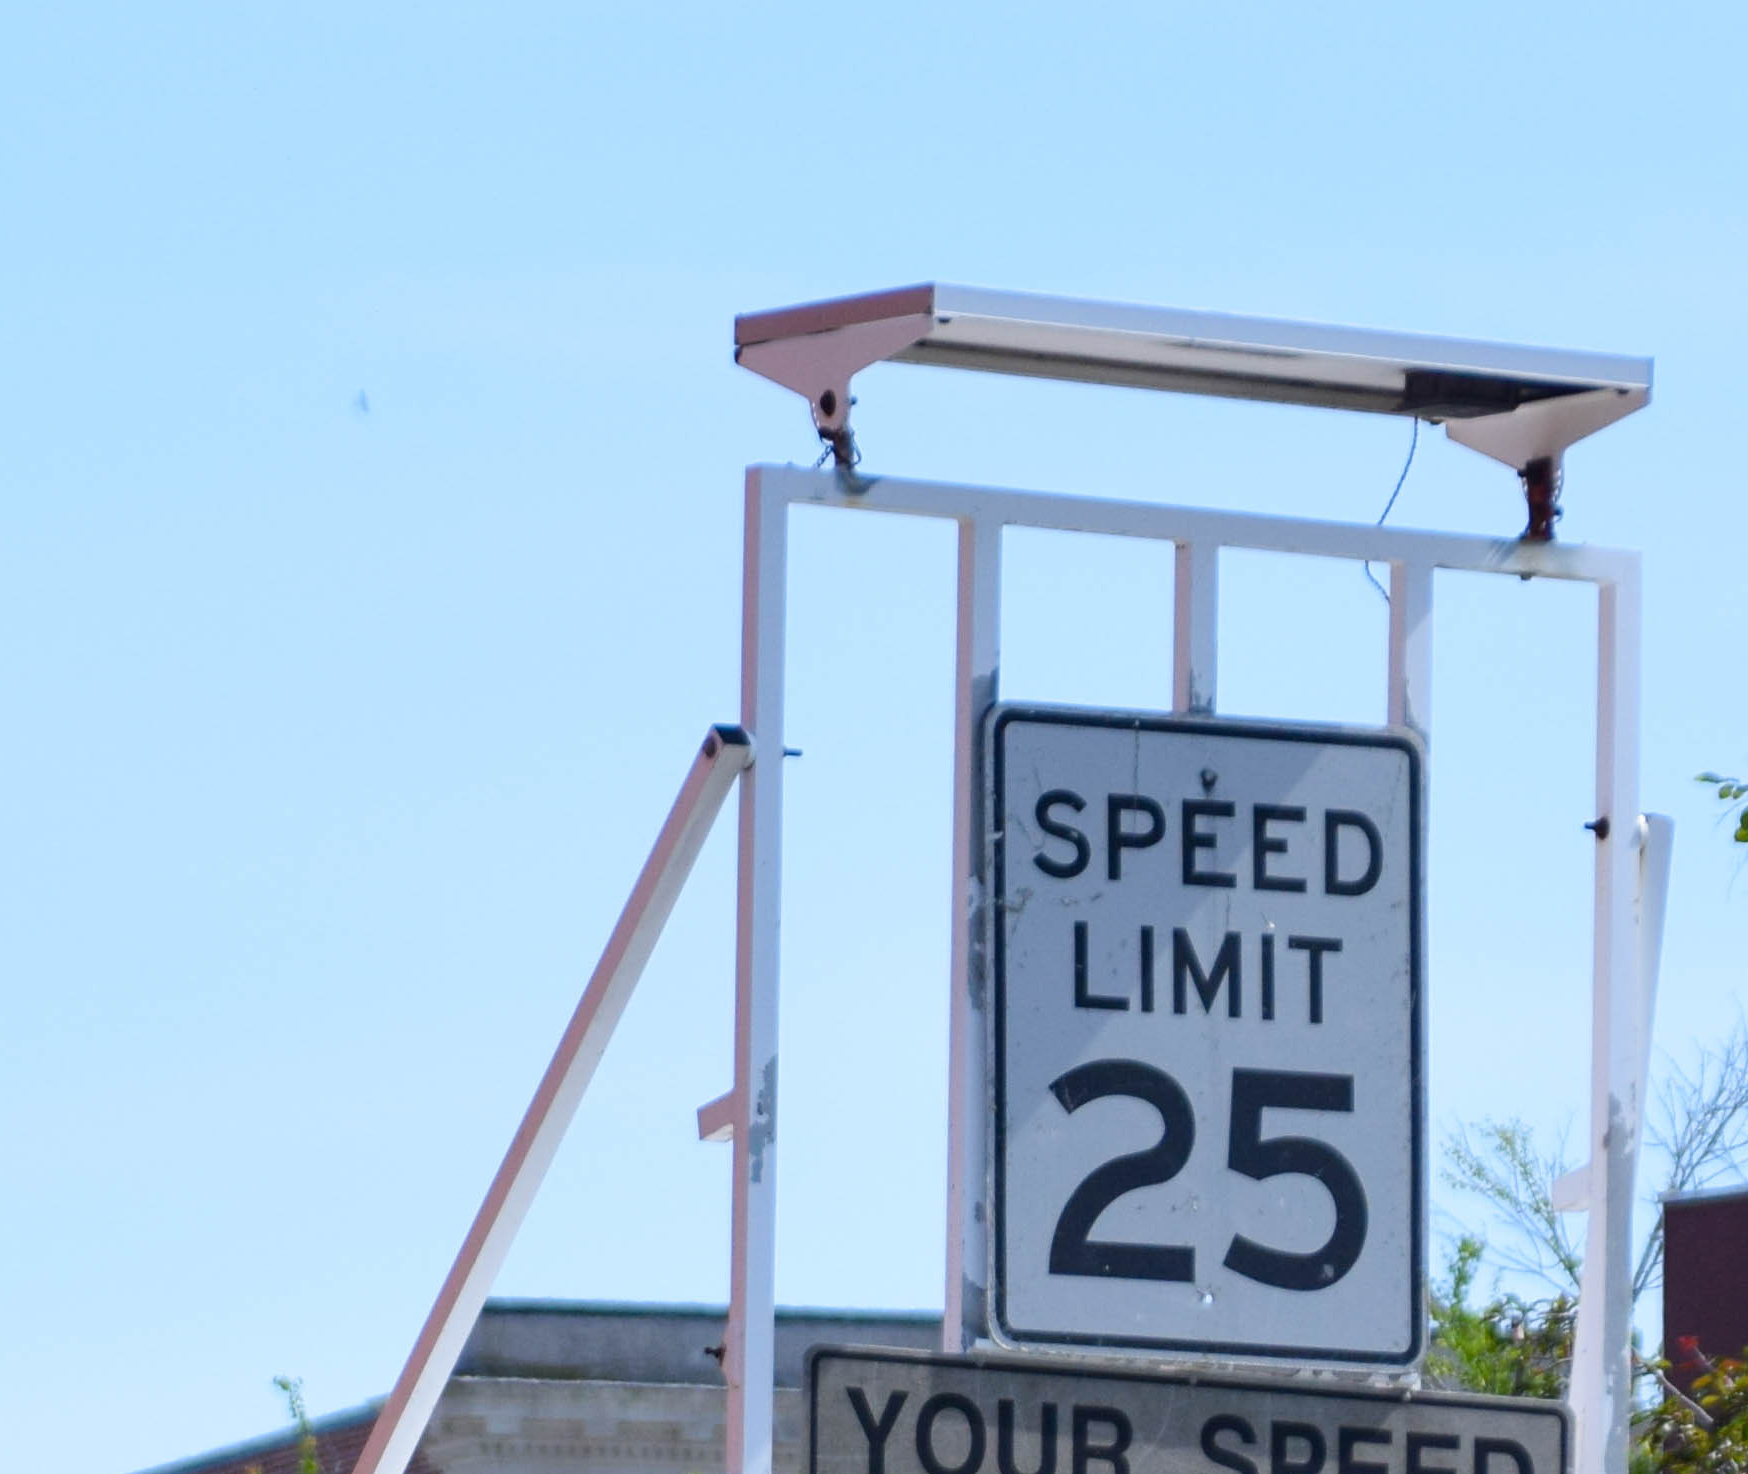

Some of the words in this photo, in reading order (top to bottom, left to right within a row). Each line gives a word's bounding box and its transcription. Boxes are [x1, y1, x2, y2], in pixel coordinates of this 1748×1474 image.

[1032, 788, 1384, 898] SPEED
[1073, 920, 1344, 1024] LIMIT
[1049, 1057, 1370, 1291] 25
